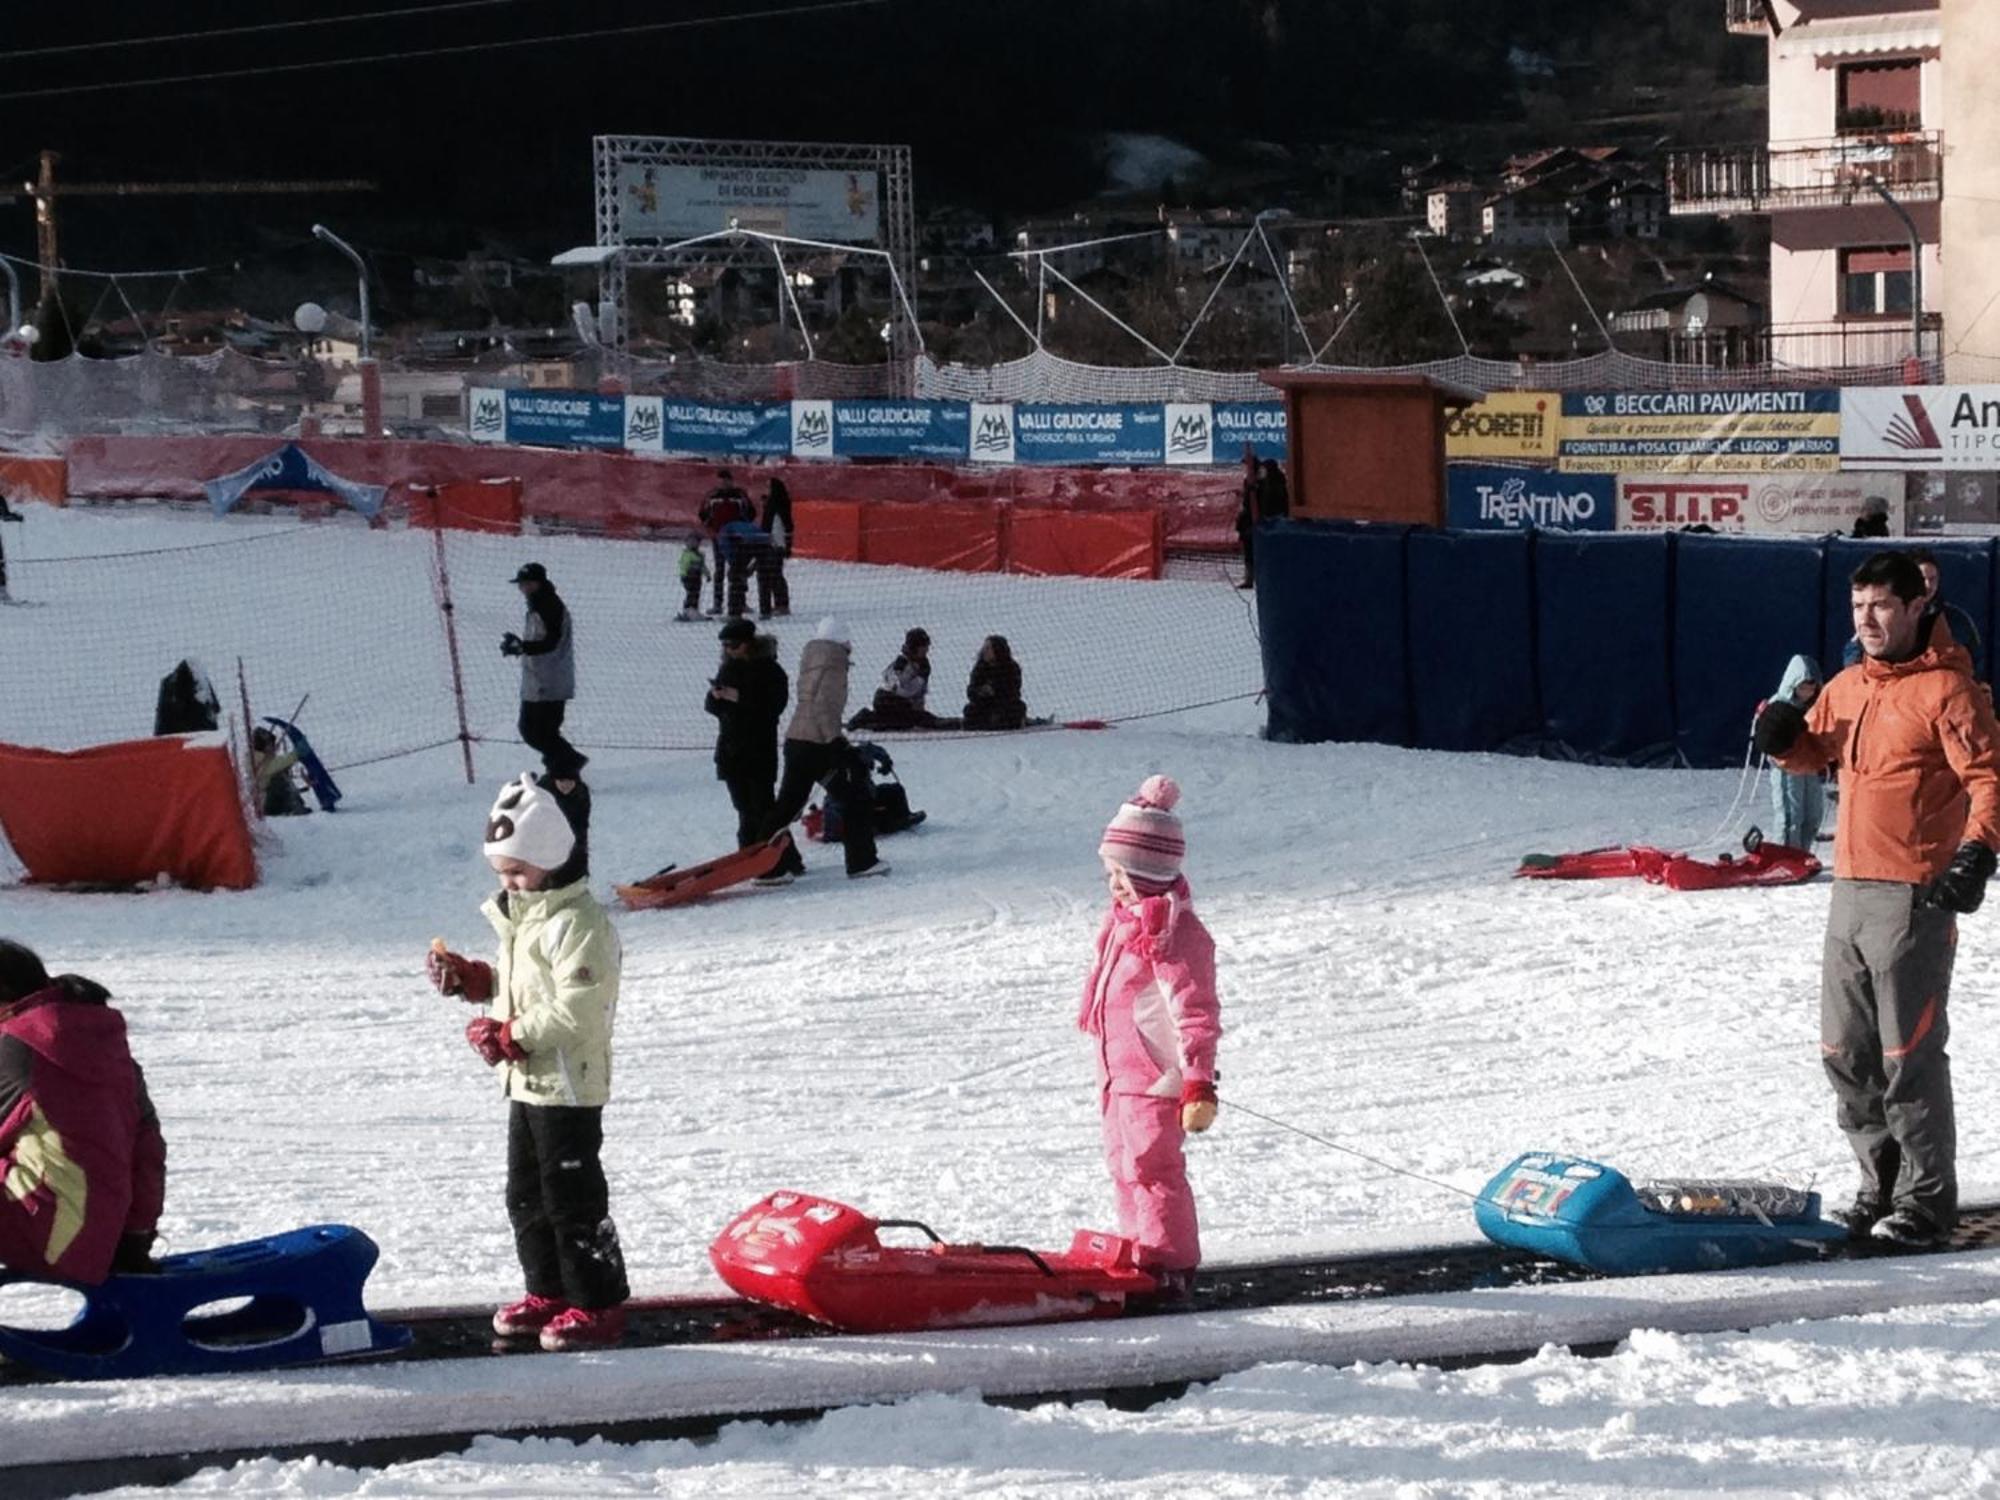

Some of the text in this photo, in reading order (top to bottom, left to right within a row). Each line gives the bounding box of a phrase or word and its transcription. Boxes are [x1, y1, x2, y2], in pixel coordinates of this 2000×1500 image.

[1615, 391, 1806, 414] BECCARI PAVIMENTI
[836, 408, 866, 424] VALLI
[867, 408, 931, 424] GIUDICARIE
[1018, 413, 1050, 429] VALLI
[1052, 413, 1123, 429] GIUDICARIE
[1217, 411, 1252, 428] VALLI
[1565, 442, 1626, 454] FORNITURA
[1637, 442, 1666, 454] POSA
[1740, 440, 1780, 453] LEGNO
[1476, 486, 1596, 527] TRENTINO
